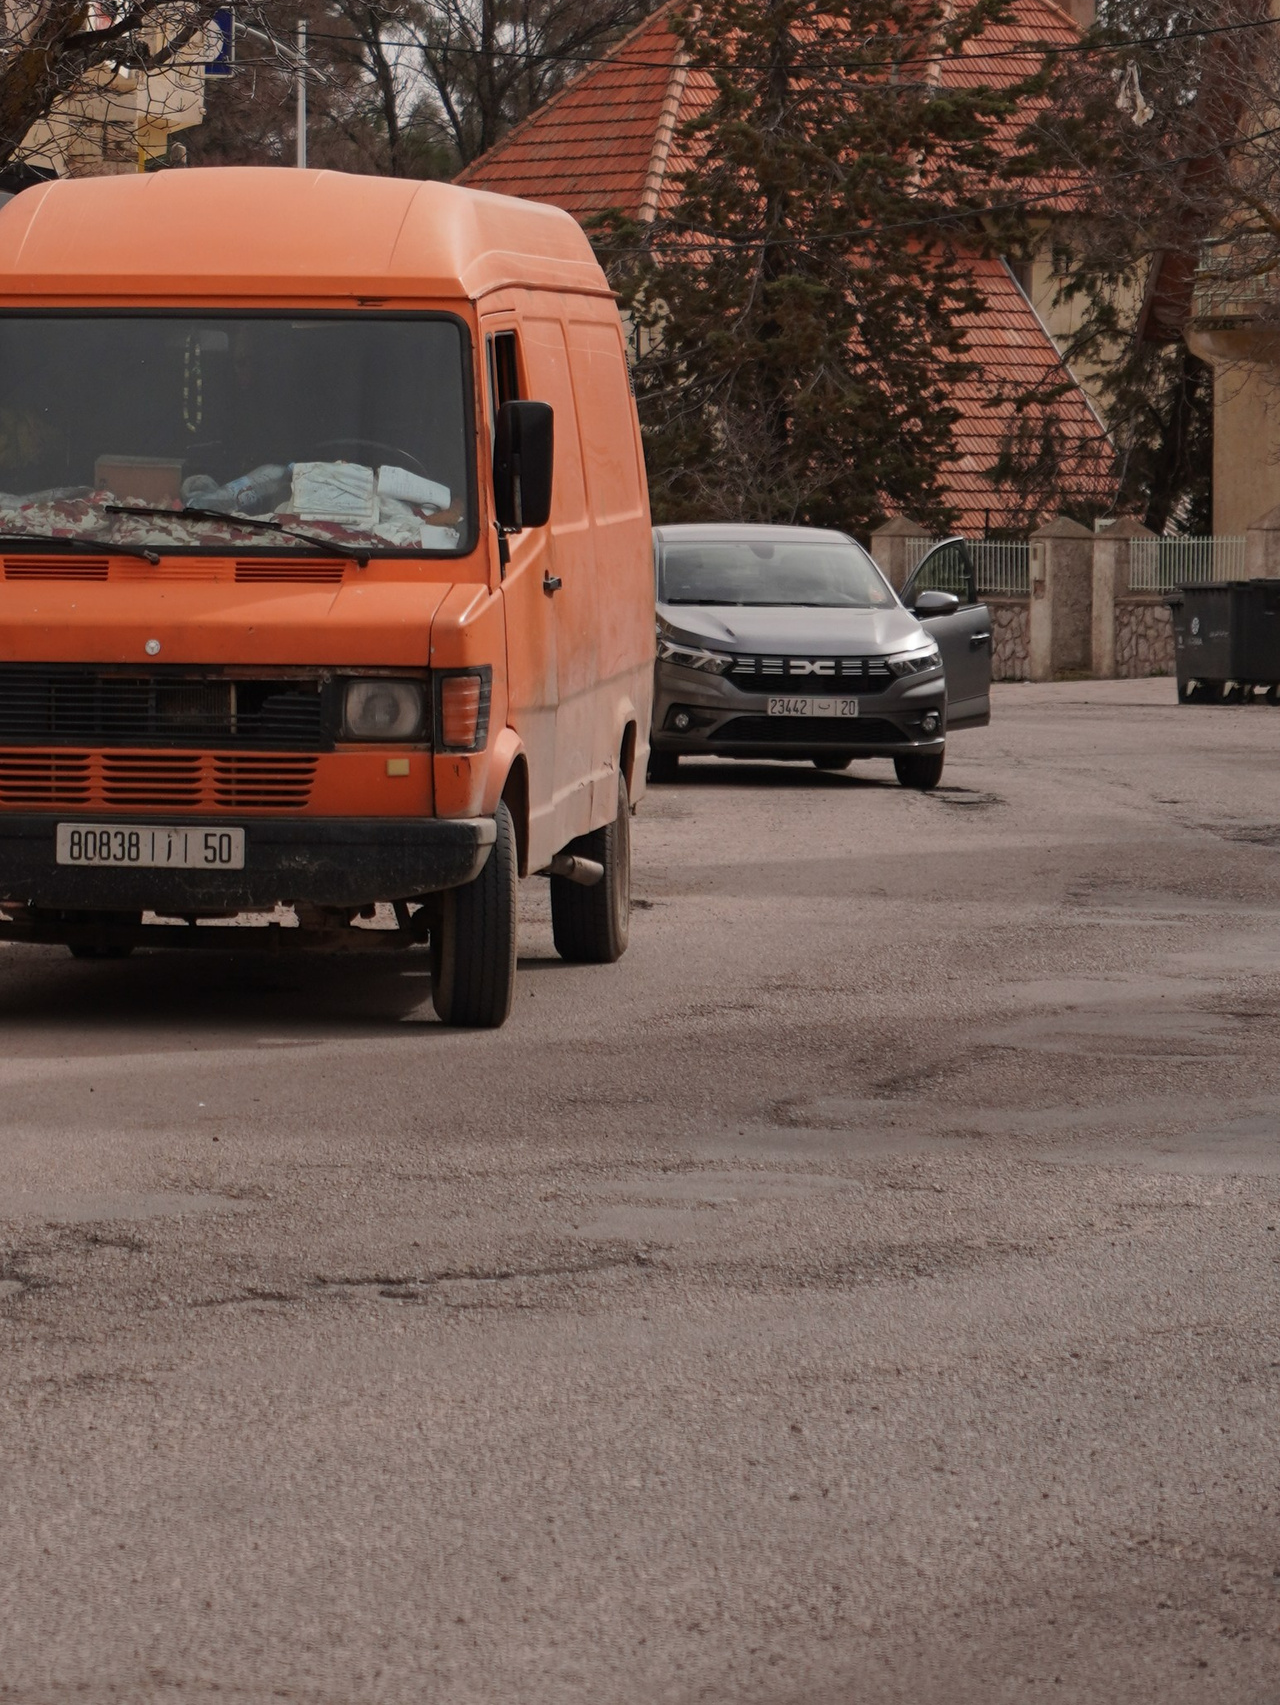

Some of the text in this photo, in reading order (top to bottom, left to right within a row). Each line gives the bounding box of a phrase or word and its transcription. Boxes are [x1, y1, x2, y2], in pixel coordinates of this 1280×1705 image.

[770, 699, 807, 715] 23442
[841, 700, 856, 716] 20
[70, 830, 141, 862] 80838
[204, 833, 232, 863] 50
